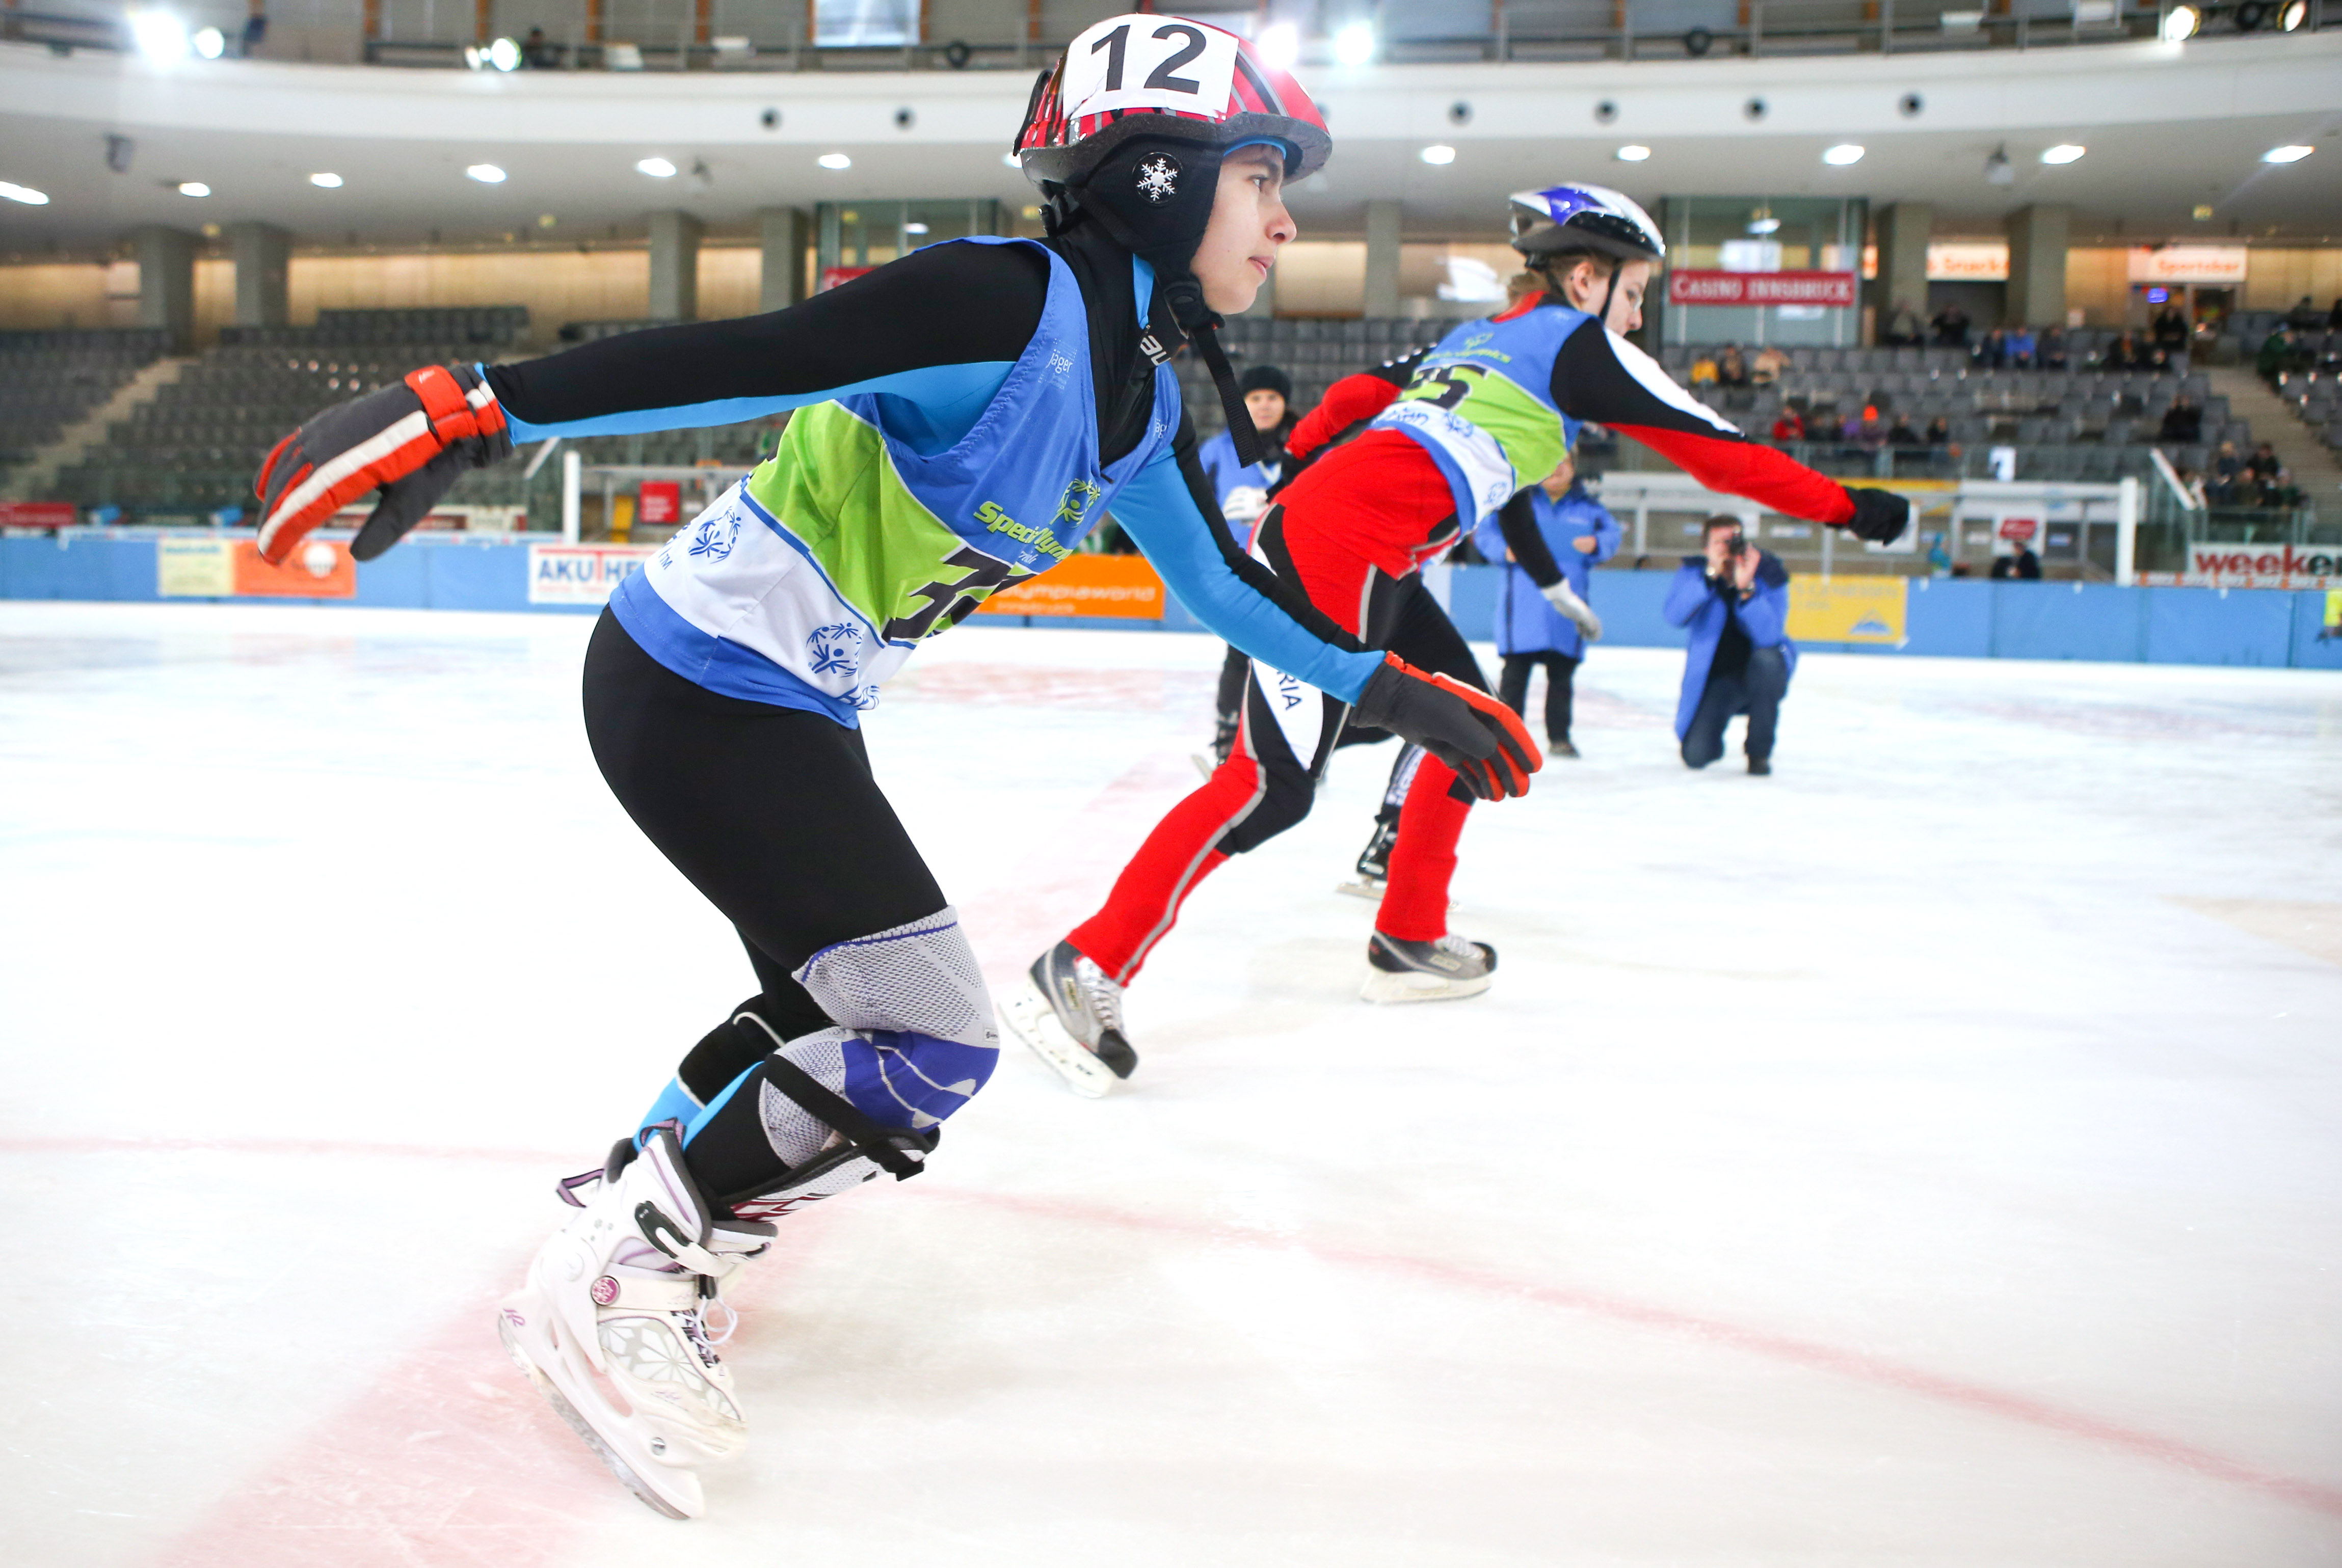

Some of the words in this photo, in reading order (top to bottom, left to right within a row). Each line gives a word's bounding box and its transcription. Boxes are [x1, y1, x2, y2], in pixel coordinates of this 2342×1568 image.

[1091, 24, 1207, 95] 12
[1747, 278, 1852, 302] INNSBRUCK
[1045, 349, 1073, 374] jäger
